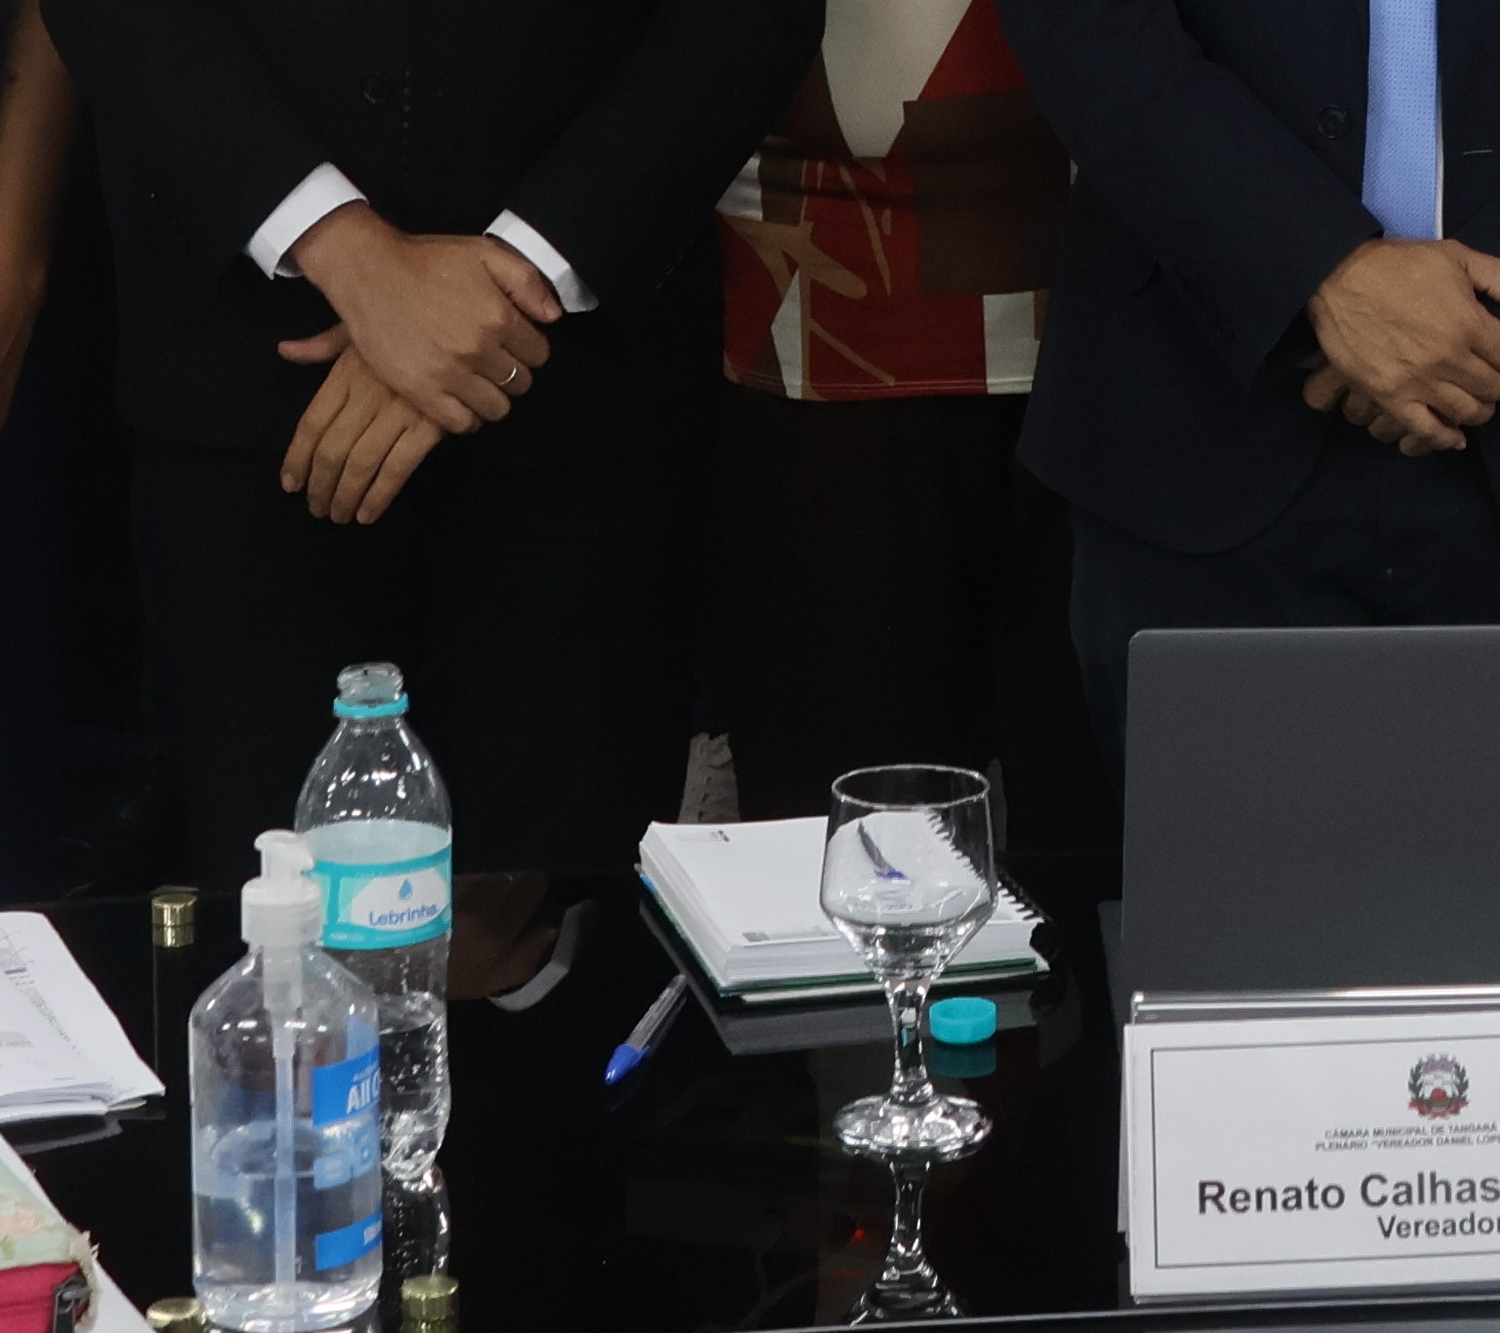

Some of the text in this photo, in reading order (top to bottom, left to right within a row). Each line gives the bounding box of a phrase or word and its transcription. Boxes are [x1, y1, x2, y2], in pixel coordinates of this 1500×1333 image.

[1431, 1124, 1446, 1135] DE
[1197, 1175, 1346, 1215] Renato
[1359, 1169, 1500, 1208] Calhas
